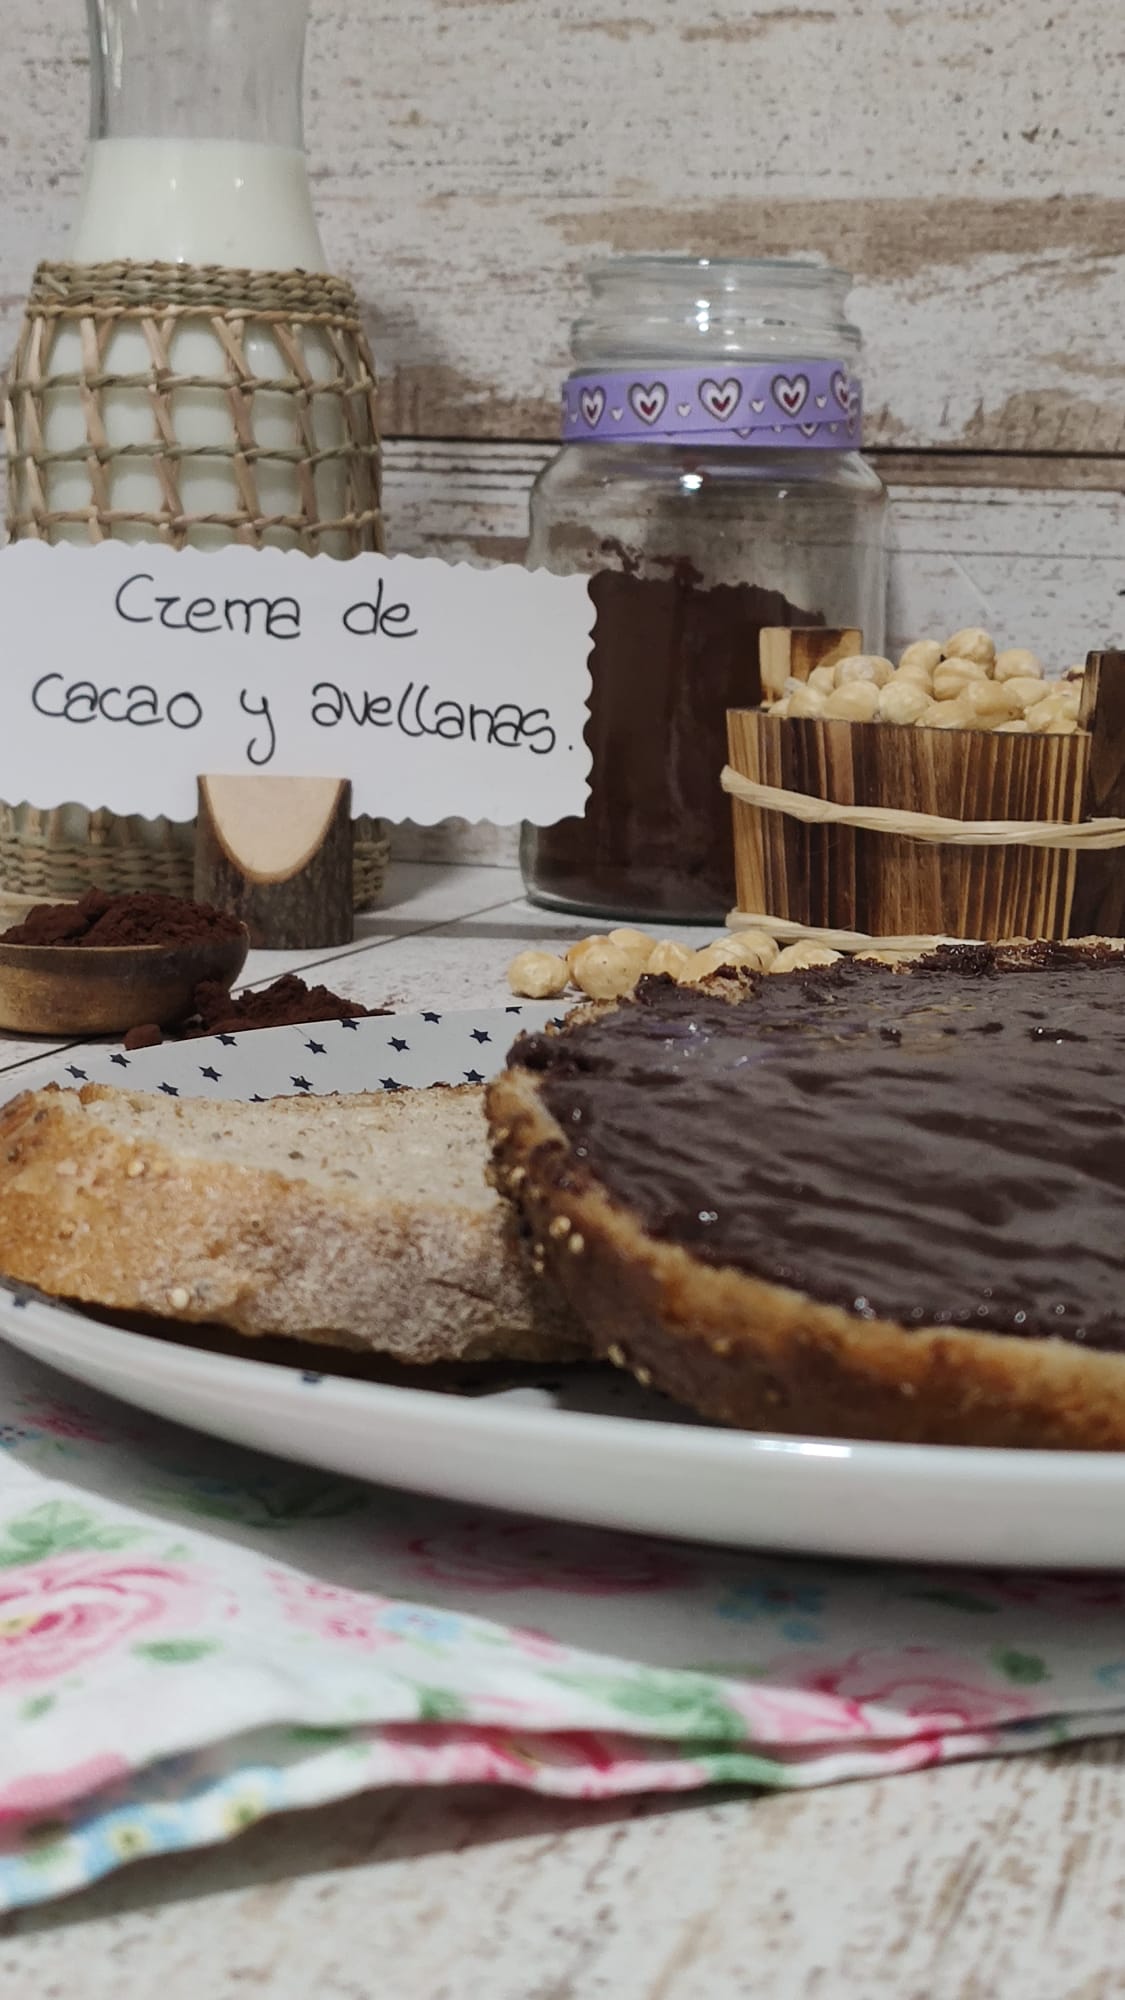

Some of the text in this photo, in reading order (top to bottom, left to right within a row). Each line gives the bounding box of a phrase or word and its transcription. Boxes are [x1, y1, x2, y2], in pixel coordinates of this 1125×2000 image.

[115, 574, 419, 640] Crema de
[239, 688, 276, 766] y
[311, 682, 574, 755] avellanas.
